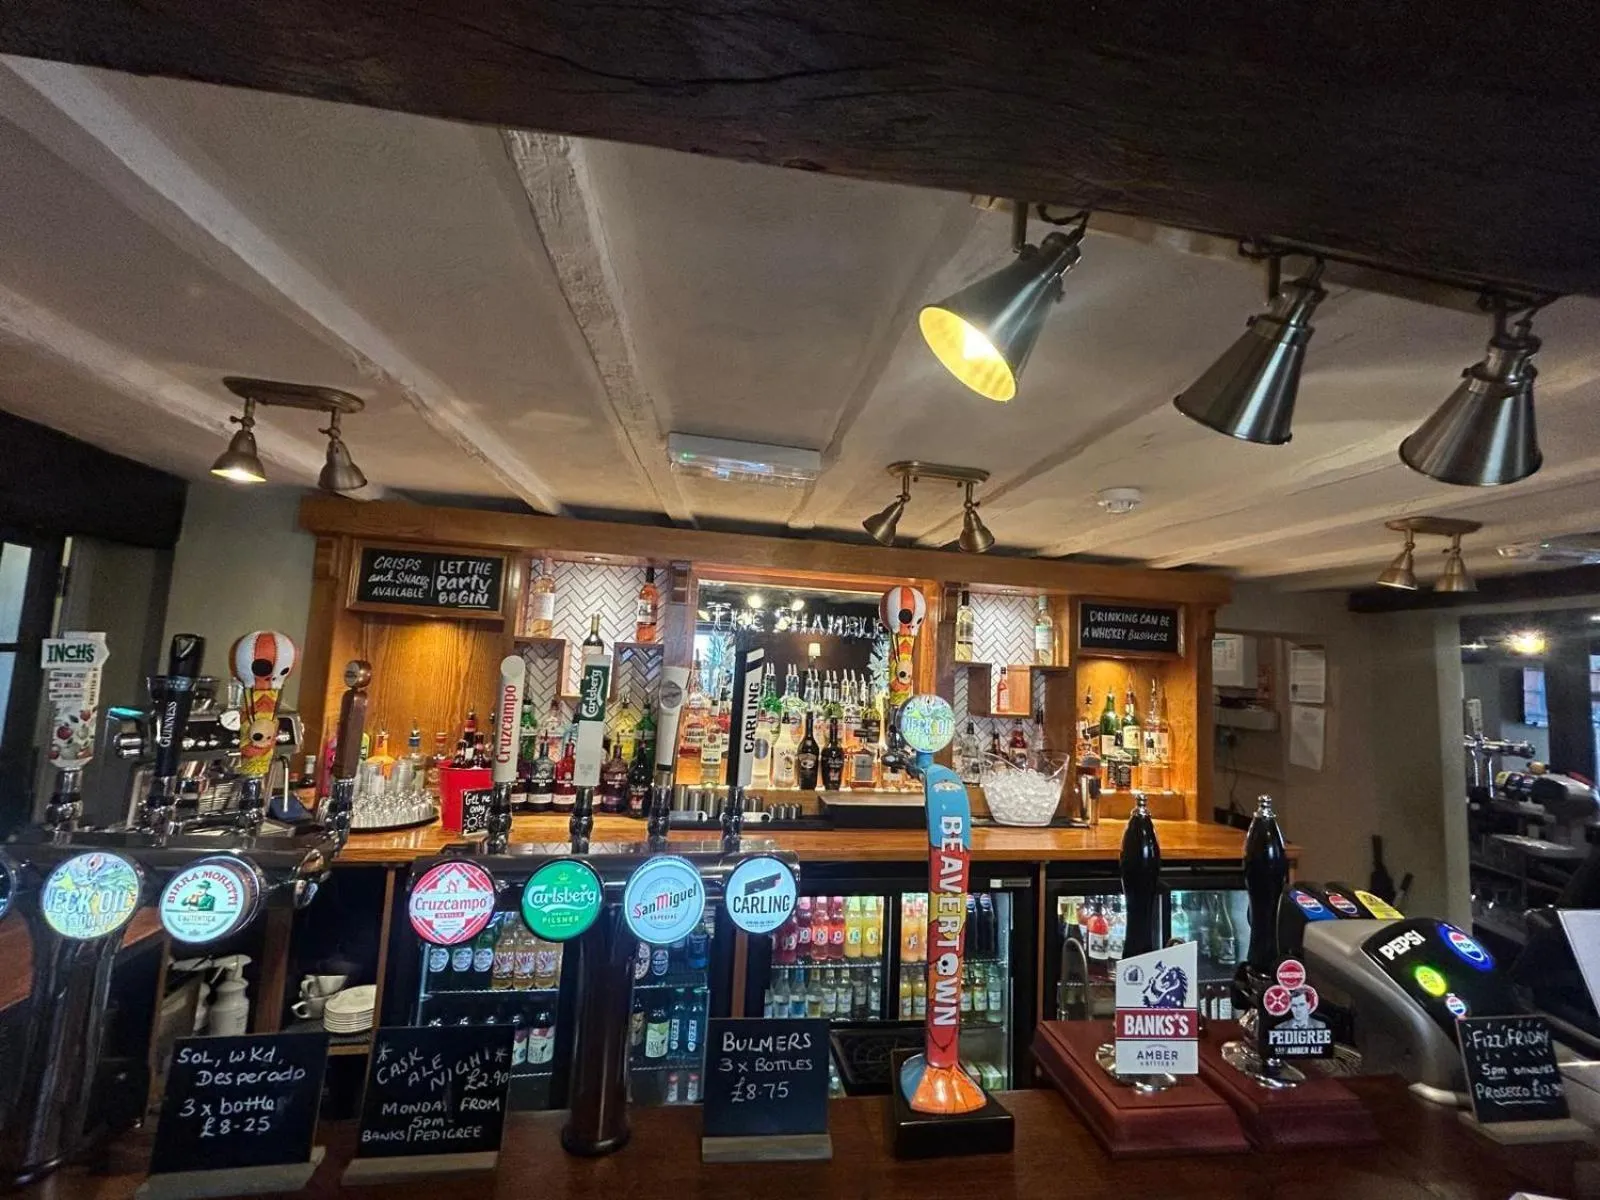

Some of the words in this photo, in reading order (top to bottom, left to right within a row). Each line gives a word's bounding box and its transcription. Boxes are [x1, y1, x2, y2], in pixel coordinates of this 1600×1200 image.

[374, 556, 422, 571] CRISPS
[440, 560, 465, 574] LET
[468, 561, 492, 575] THE
[368, 571, 396, 583] and
[396, 572, 430, 589] SNACKS
[372, 586, 424, 598] AVAILABLE
[773, 606, 886, 639] SHAMBLE
[1089, 610, 1138, 624] DRINKING
[1140, 613, 1158, 626] CAN
[1160, 615, 1170, 627] BE
[1083, 627, 1090, 639] A
[1091, 626, 1127, 640] WHISKEY
[581, 669, 604, 717] Carlsberg
[160, 701, 177, 748] GUINNESS
[496, 684, 518, 764] Cruzcampo
[744, 682, 760, 754] CARLING
[167, 872, 200, 904] BIRRA
[202, 870, 239, 905] MORETTI
[527, 884, 597, 910] Carlsberg
[415, 896, 488, 913] Cruzcampo
[733, 894, 790, 914] CARLING
[1378, 929, 1427, 961] PEPSI
[722, 1032, 812, 1052] BULMERS
[1268, 1030, 1331, 1045] PEDIGREE
[719, 1058, 734, 1072] 3
[755, 1058, 813, 1071] BOTTLES
[1136, 1051, 1179, 1060] AMBER
[195, 1066, 306, 1087] Desperado
[377, 1047, 423, 1085] CASK
[408, 1053, 443, 1087] ALE
[731, 1076, 789, 1103] £8.75
[1476, 1082, 1531, 1100] PROSECCO
[179, 1099, 195, 1117] 3
[460, 1097, 501, 1112] FROM
